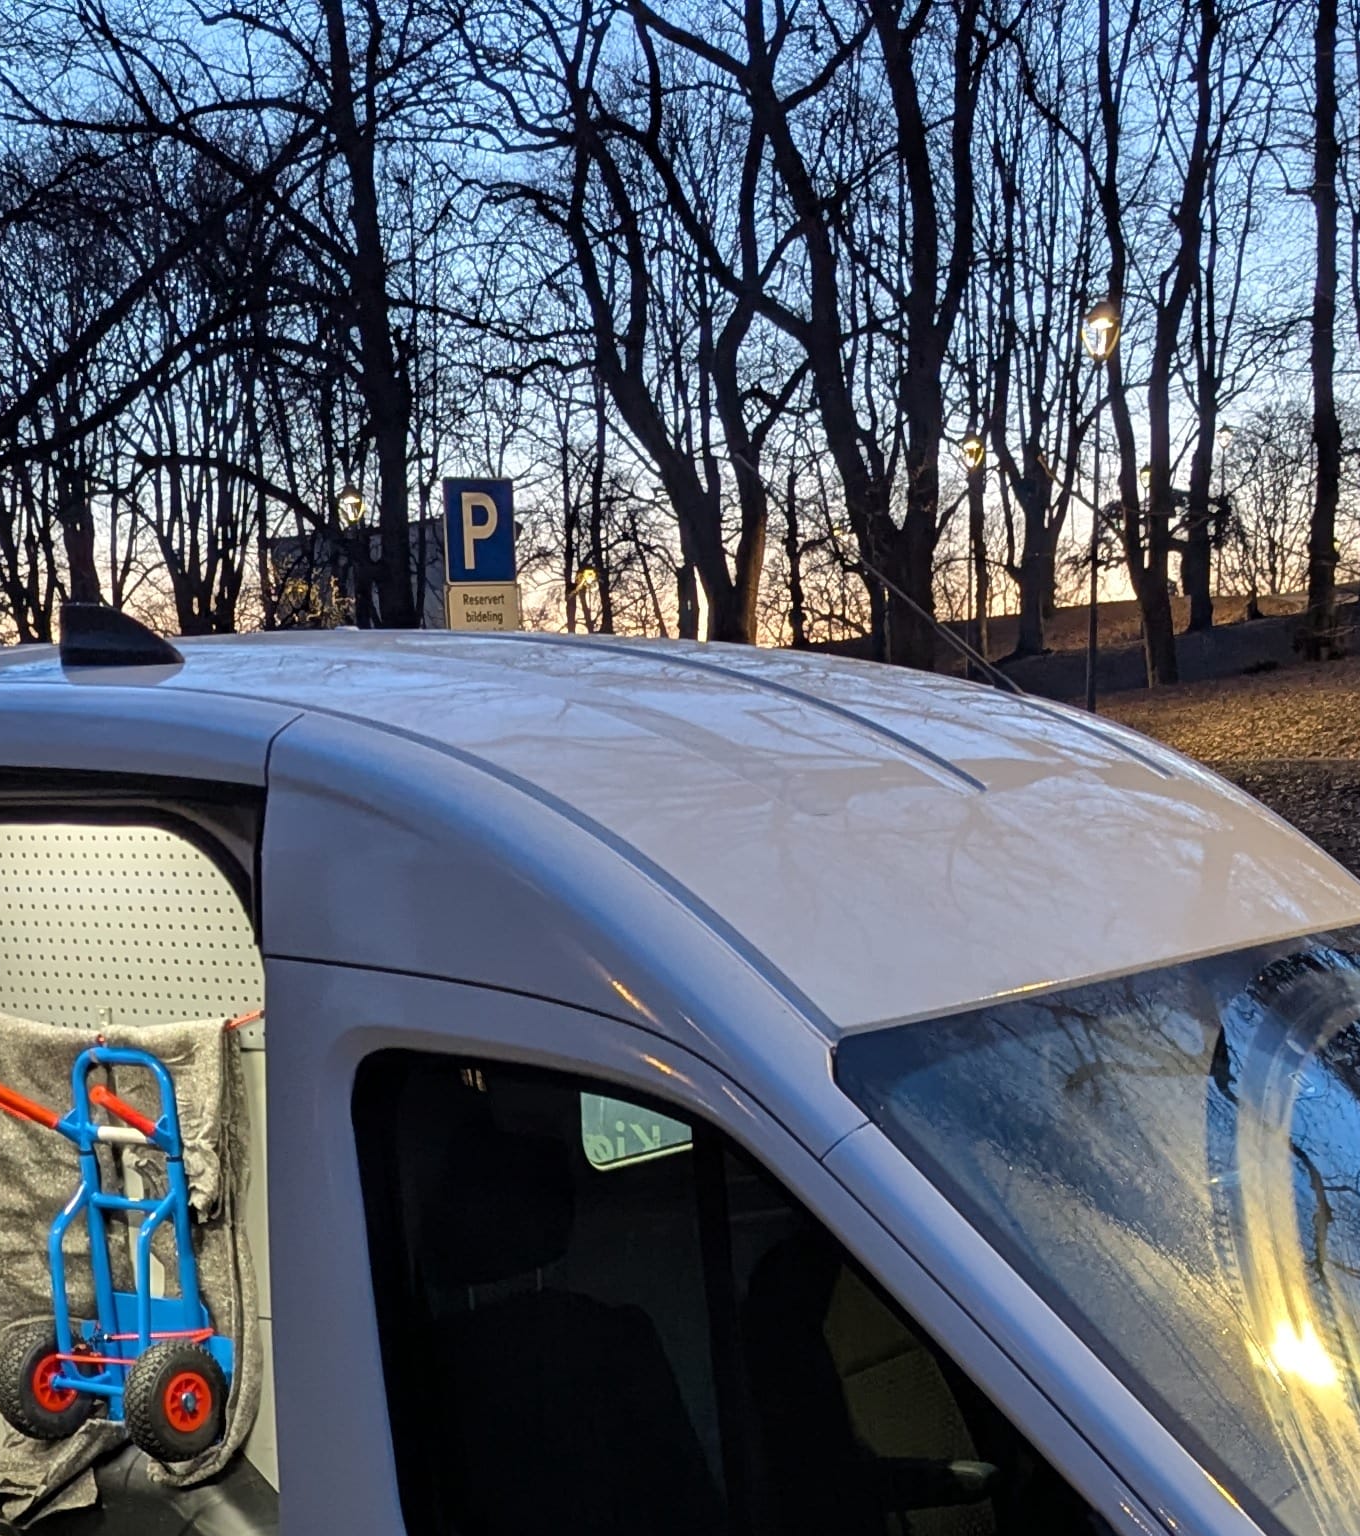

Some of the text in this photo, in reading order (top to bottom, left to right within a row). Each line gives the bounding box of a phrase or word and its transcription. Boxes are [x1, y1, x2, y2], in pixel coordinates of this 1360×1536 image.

[461, 491, 498, 570] P
[462, 593, 505, 606] Reservert
[465, 610, 504, 625] bildeling
